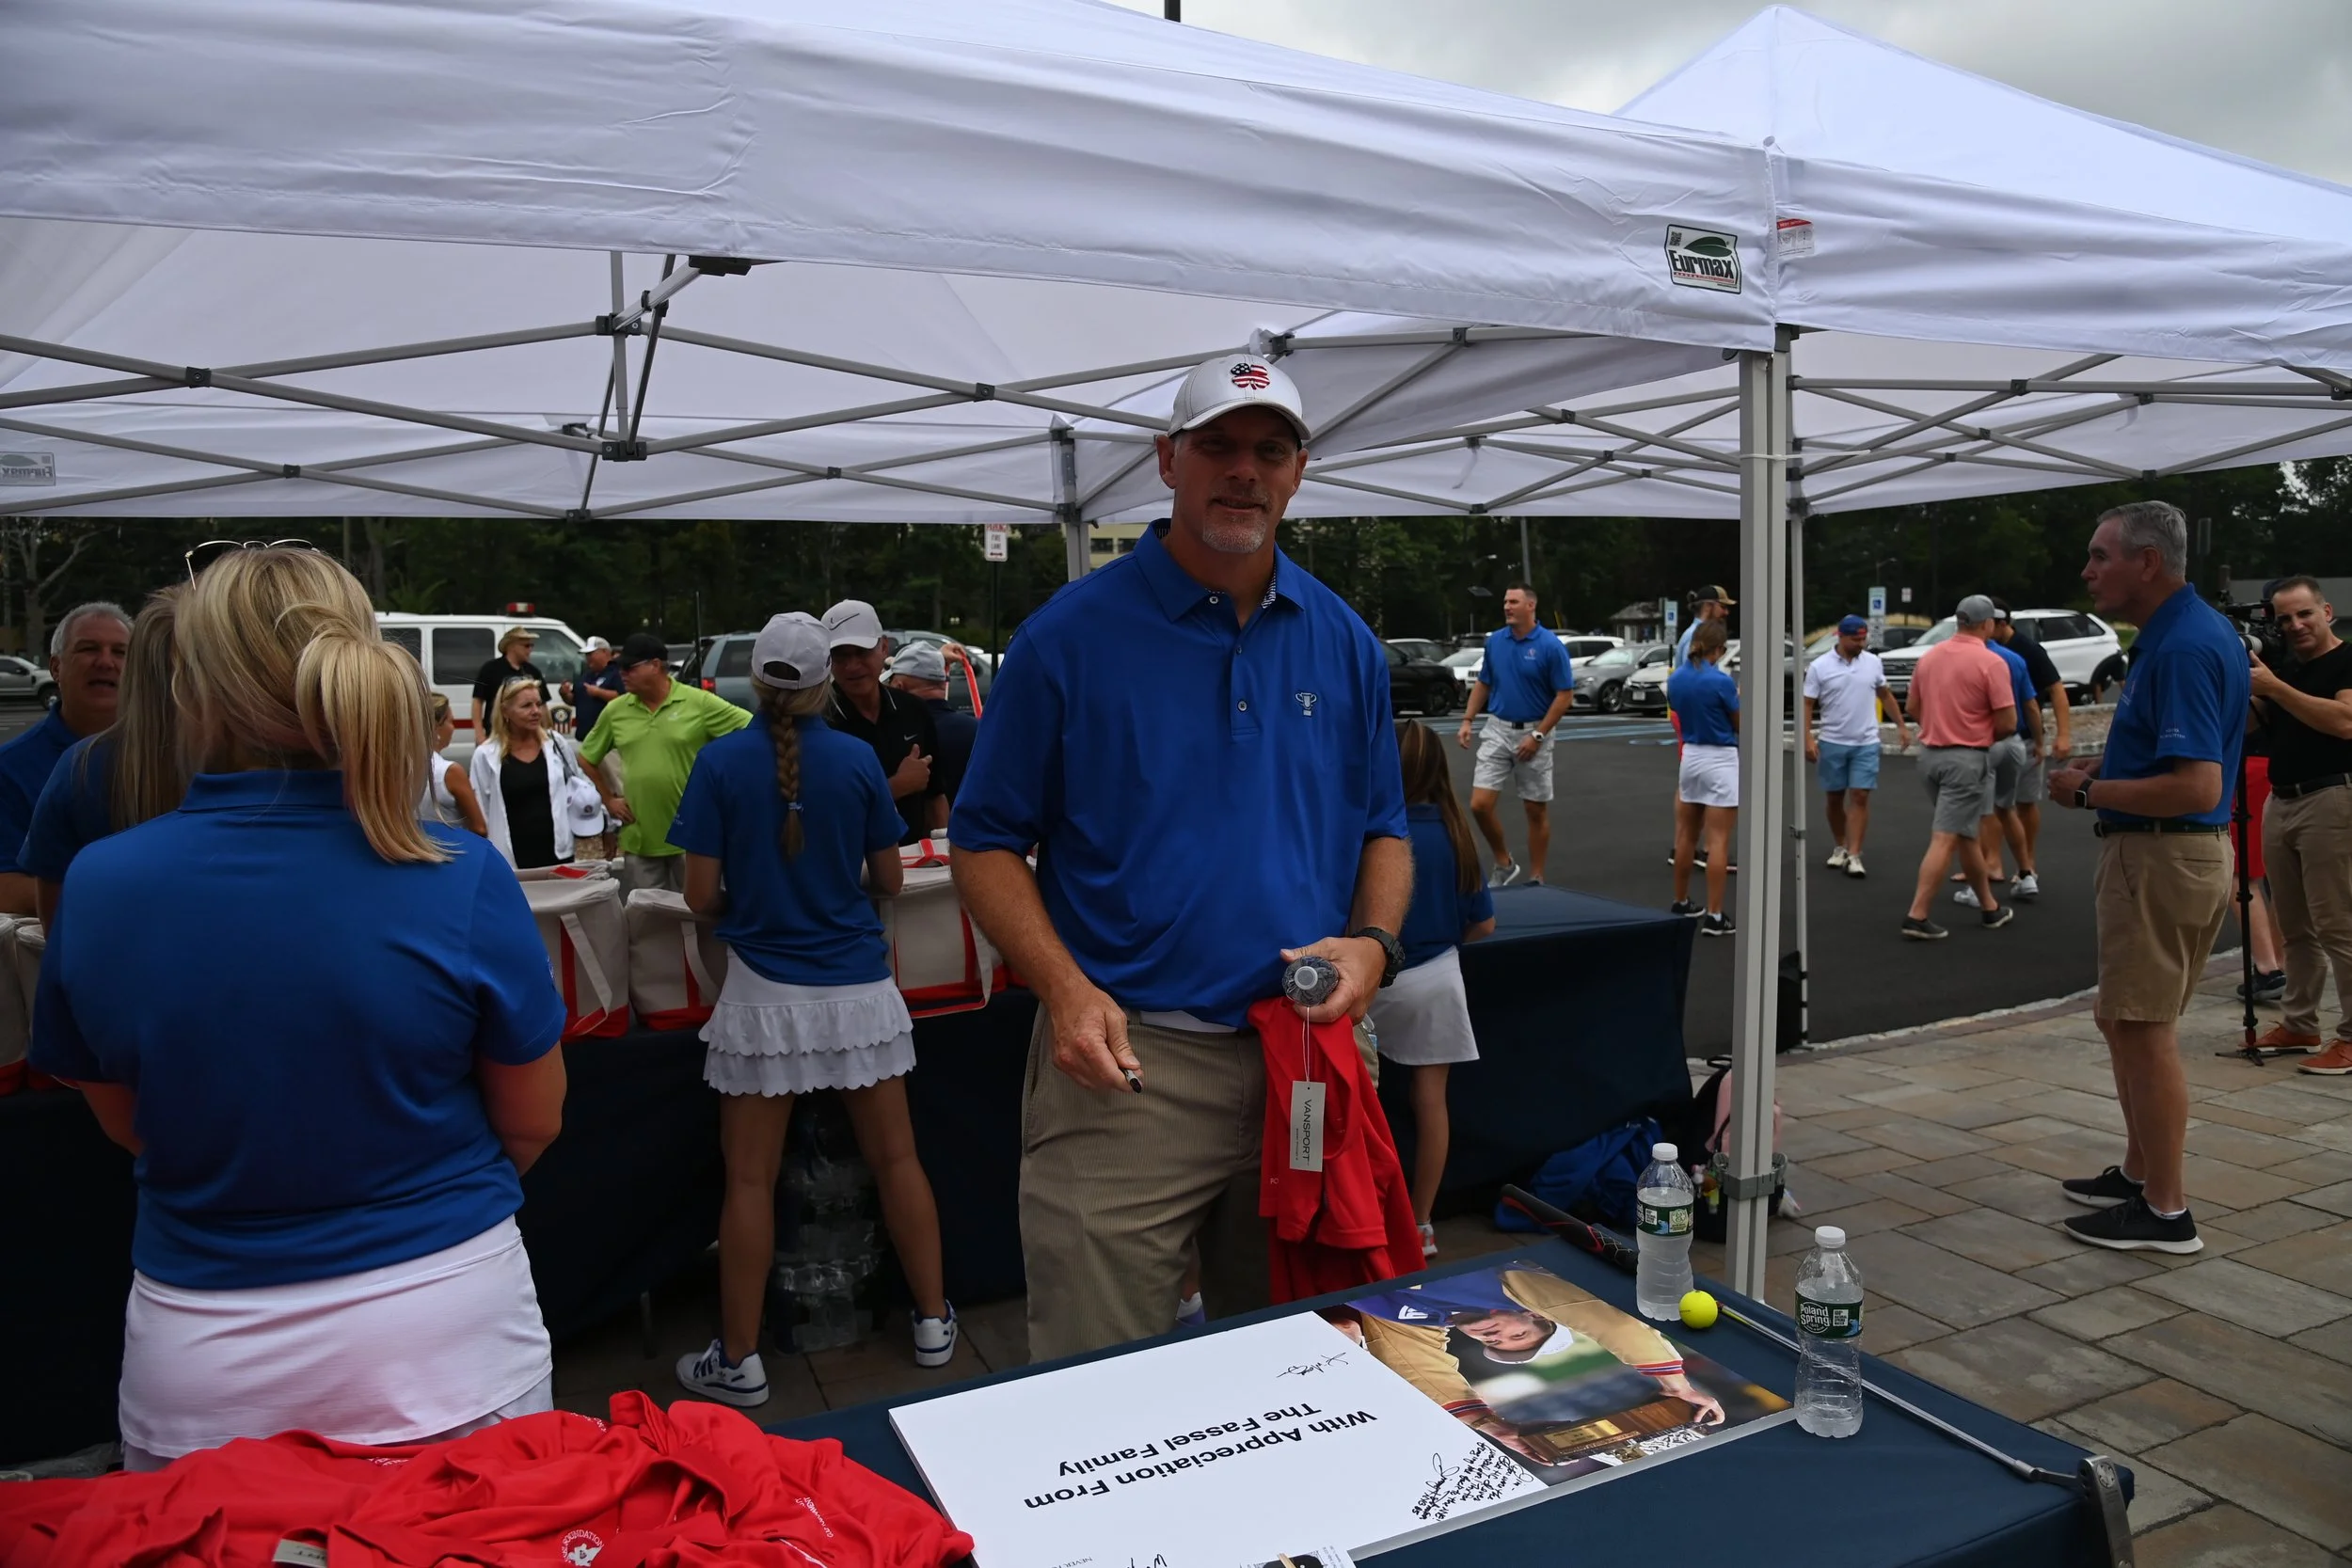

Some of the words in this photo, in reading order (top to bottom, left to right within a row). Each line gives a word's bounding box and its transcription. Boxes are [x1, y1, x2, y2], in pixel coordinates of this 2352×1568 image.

[1668, 249, 1735, 279] Eurmax
[1302, 1099, 1311, 1162] VANSPORT
[1800, 1303, 1829, 1317] Poland
[1800, 1314, 1831, 1327] Spring
[1263, 1402, 1322, 1422] The
[1308, 1410, 1377, 1433] With
[1164, 1417, 1262, 1451] Fassel
[1058, 1443, 1161, 1477] Family
[1115, 1427, 1303, 1485] Appreciation
[1023, 1479, 1110, 1509] From
